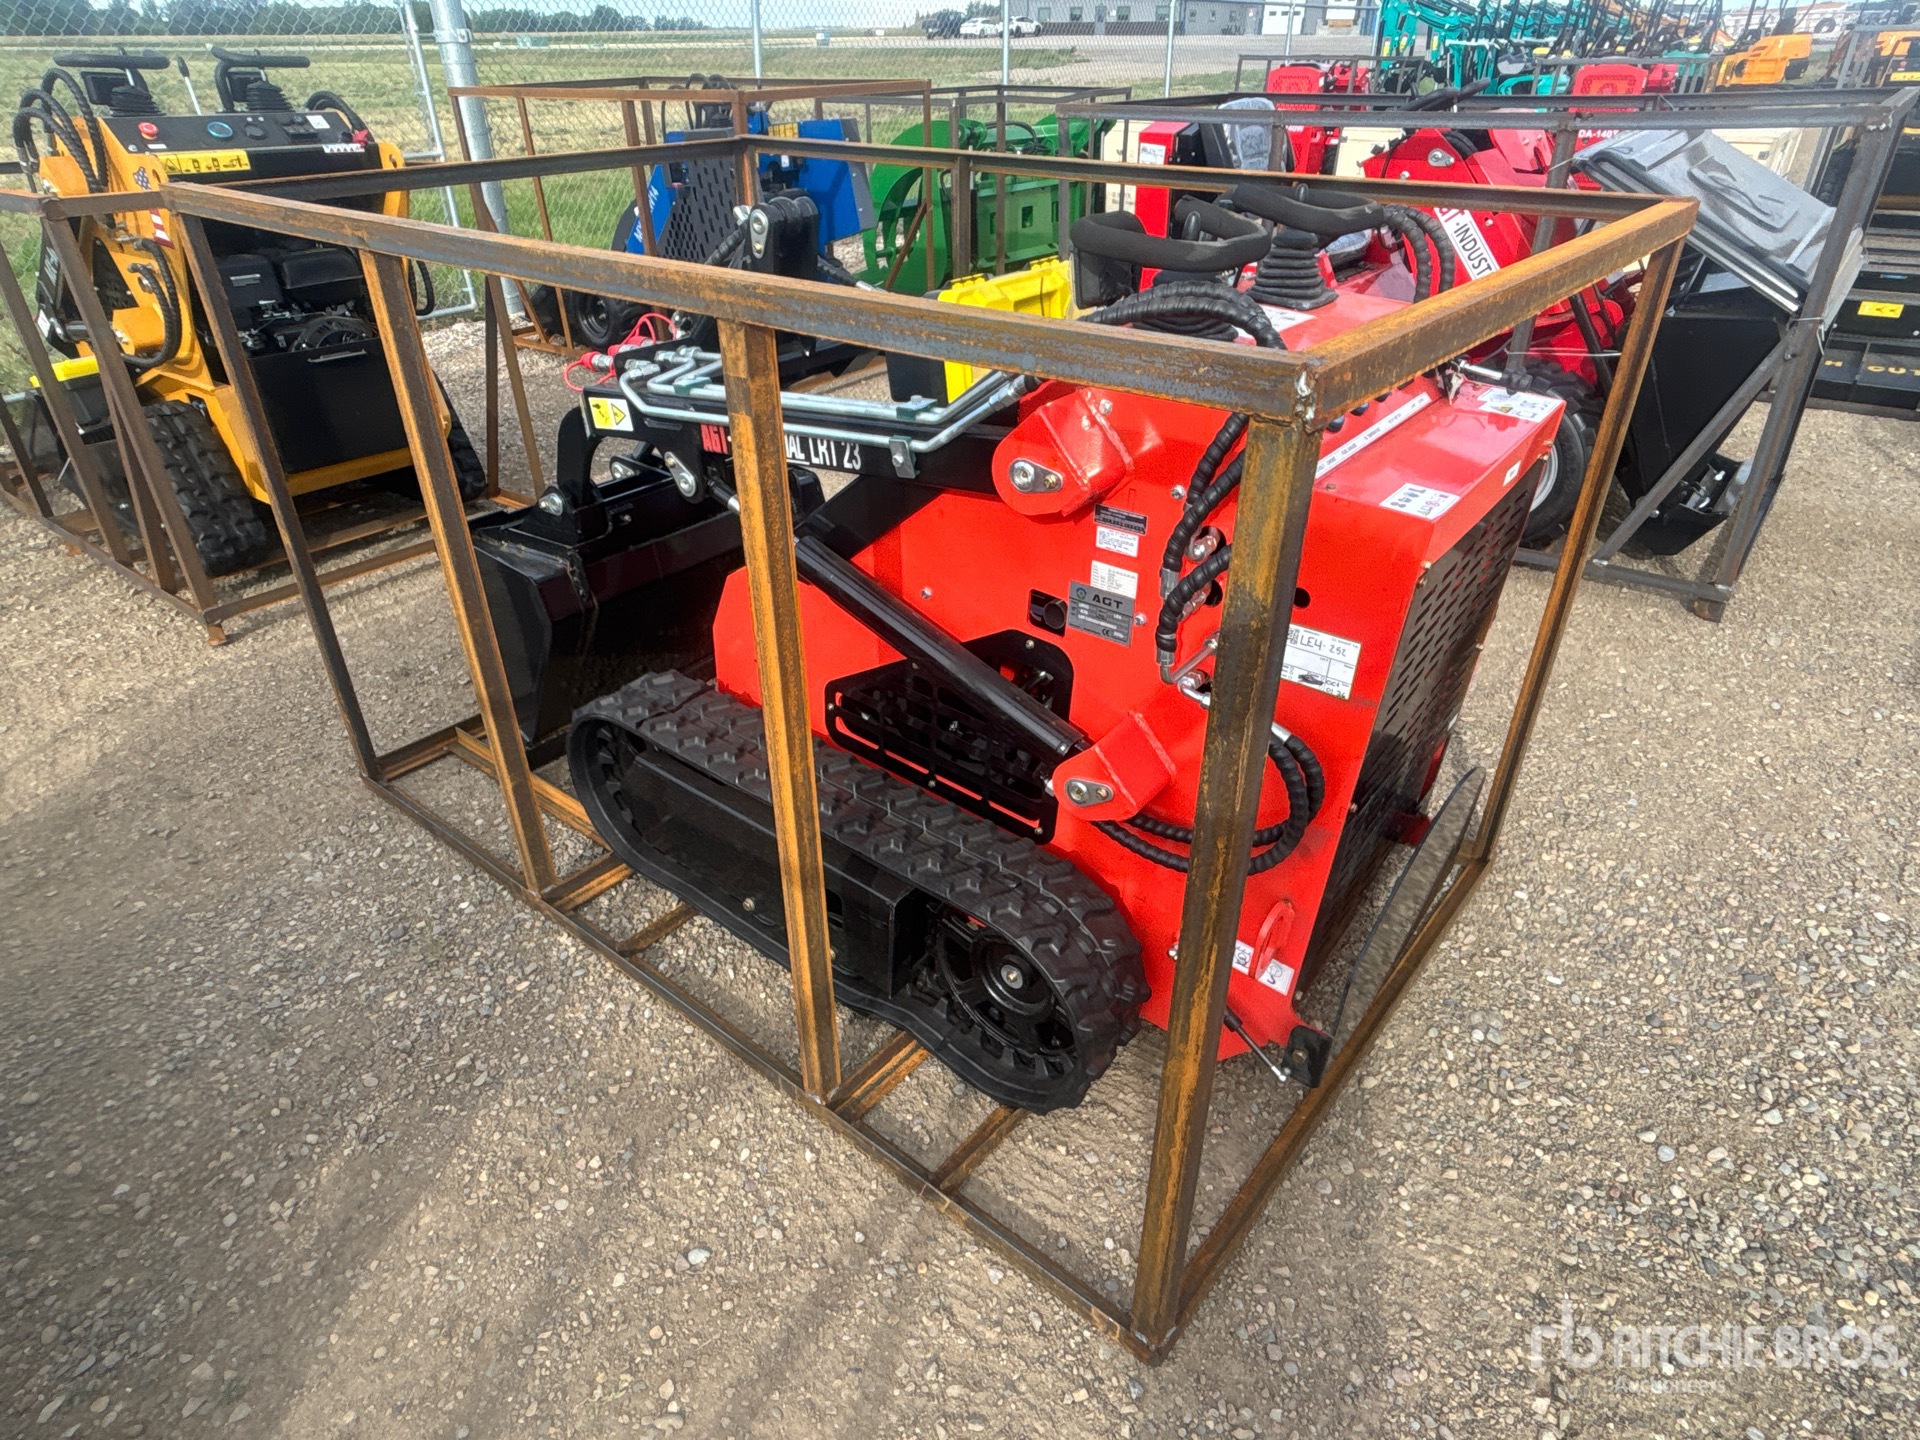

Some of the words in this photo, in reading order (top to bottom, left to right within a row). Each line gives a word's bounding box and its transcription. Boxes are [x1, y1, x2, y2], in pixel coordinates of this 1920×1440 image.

[1454, 223, 1493, 276] INDUST
[841, 440, 862, 471] 23
[1092, 593, 1123, 610] AGT
